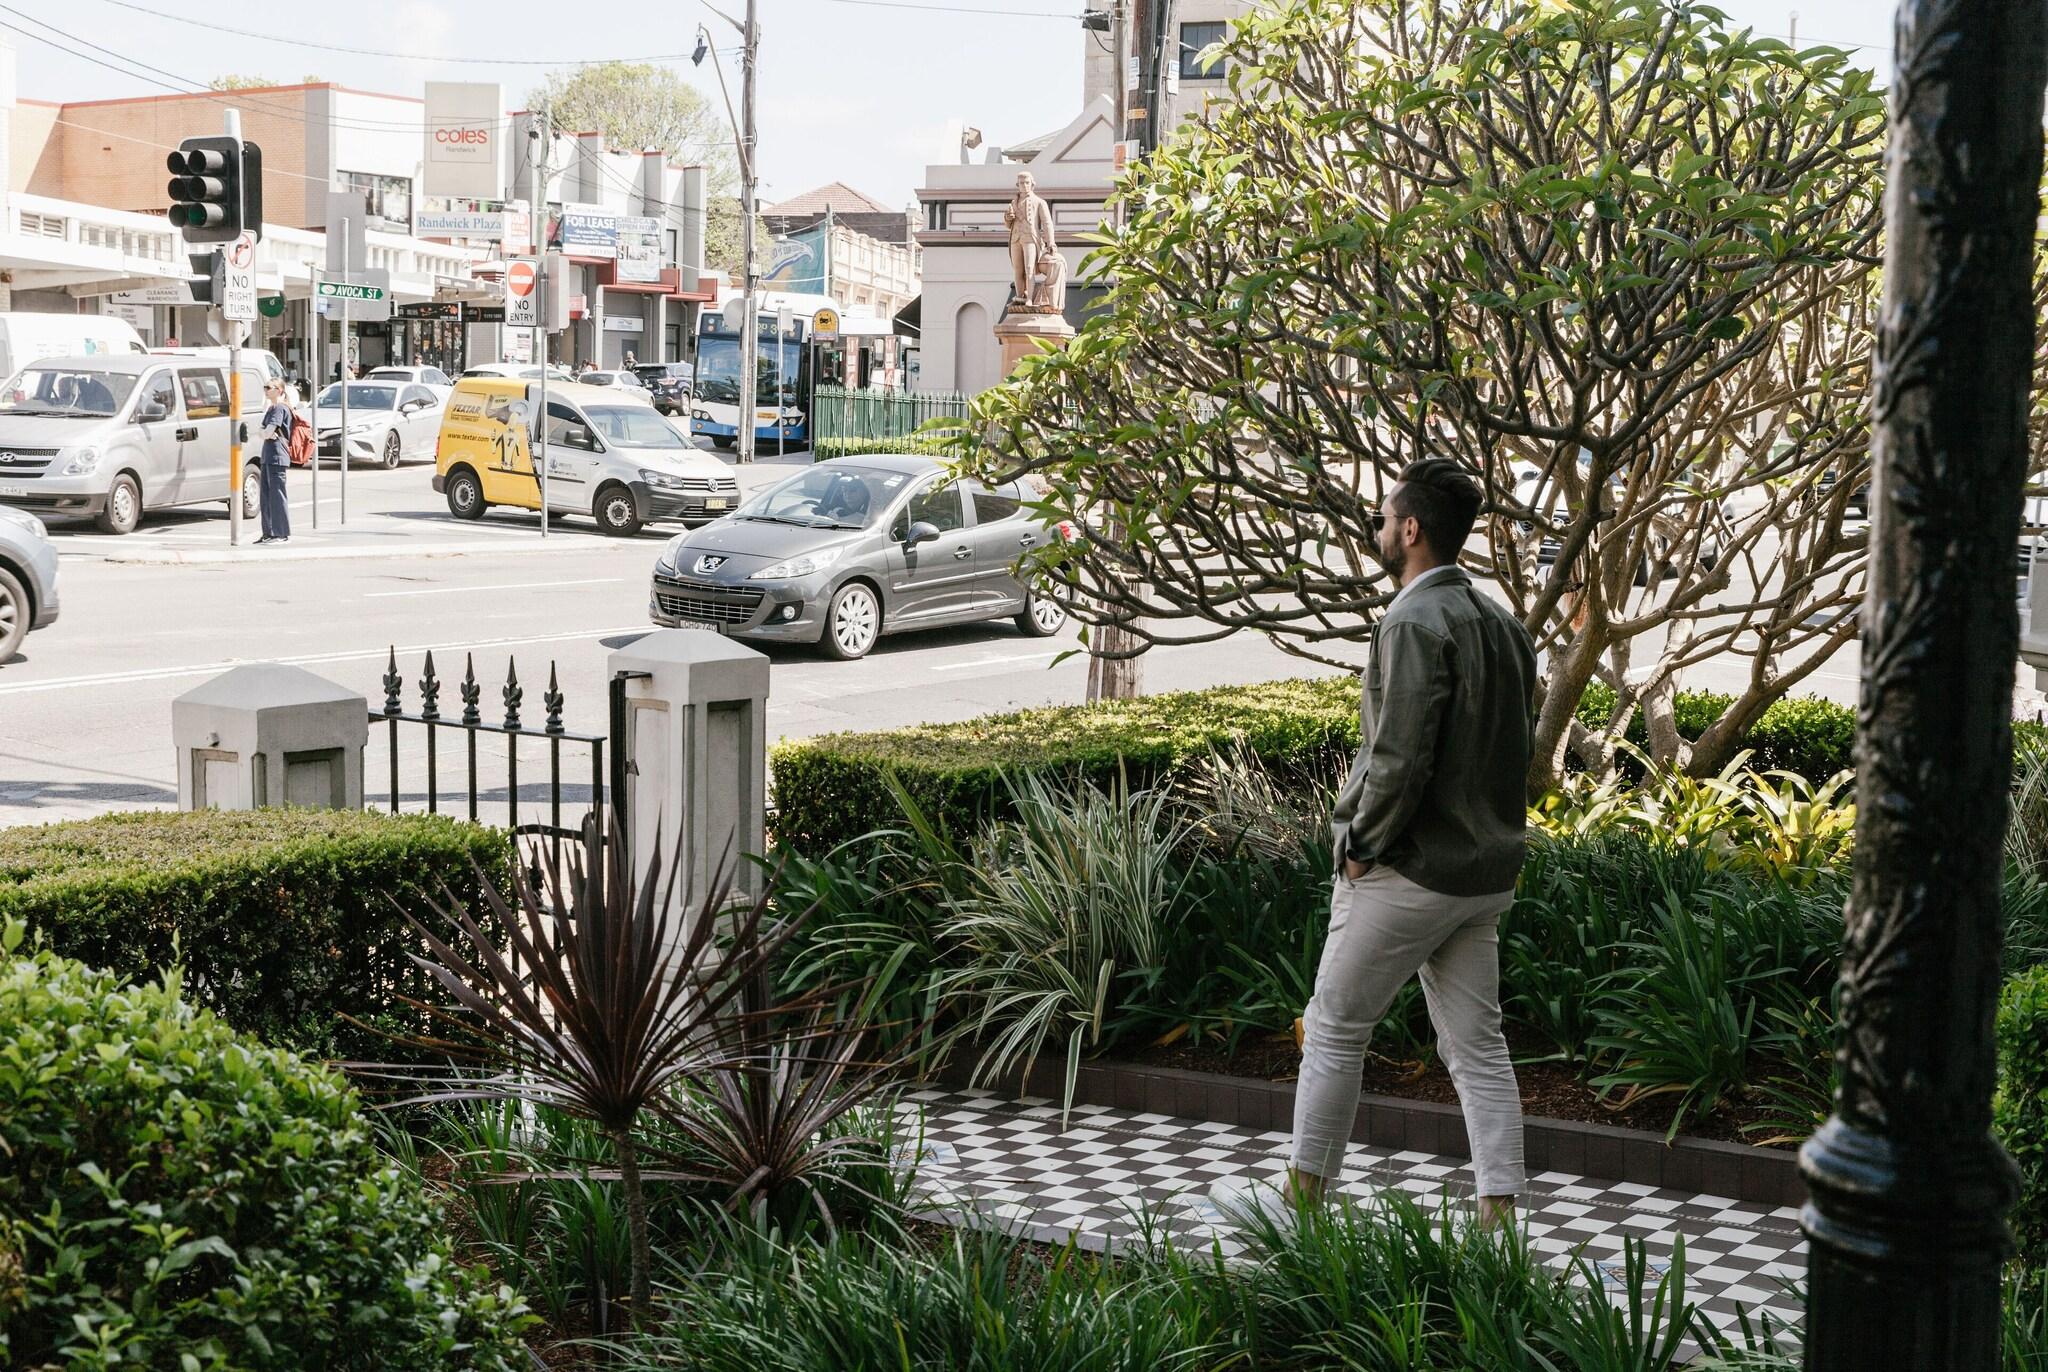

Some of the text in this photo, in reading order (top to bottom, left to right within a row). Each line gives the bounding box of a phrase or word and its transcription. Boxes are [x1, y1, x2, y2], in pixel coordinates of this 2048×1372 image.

[435, 127, 488, 144] coles
[418, 216, 469, 230] Randwick
[473, 218, 502, 230] Plaza
[565, 215, 615, 230] FOR LEASE
[232, 275, 249, 289] NO
[228, 291, 253, 302] RIGHT
[336, 285, 379, 299] AVOCA ST
[229, 303, 252, 314] TURN
[514, 300, 530, 310] NO
[510, 313, 535, 322] ENTRY
[452, 404, 482, 415] TEXTAR
[447, 432, 490, 442] www.textar.com
